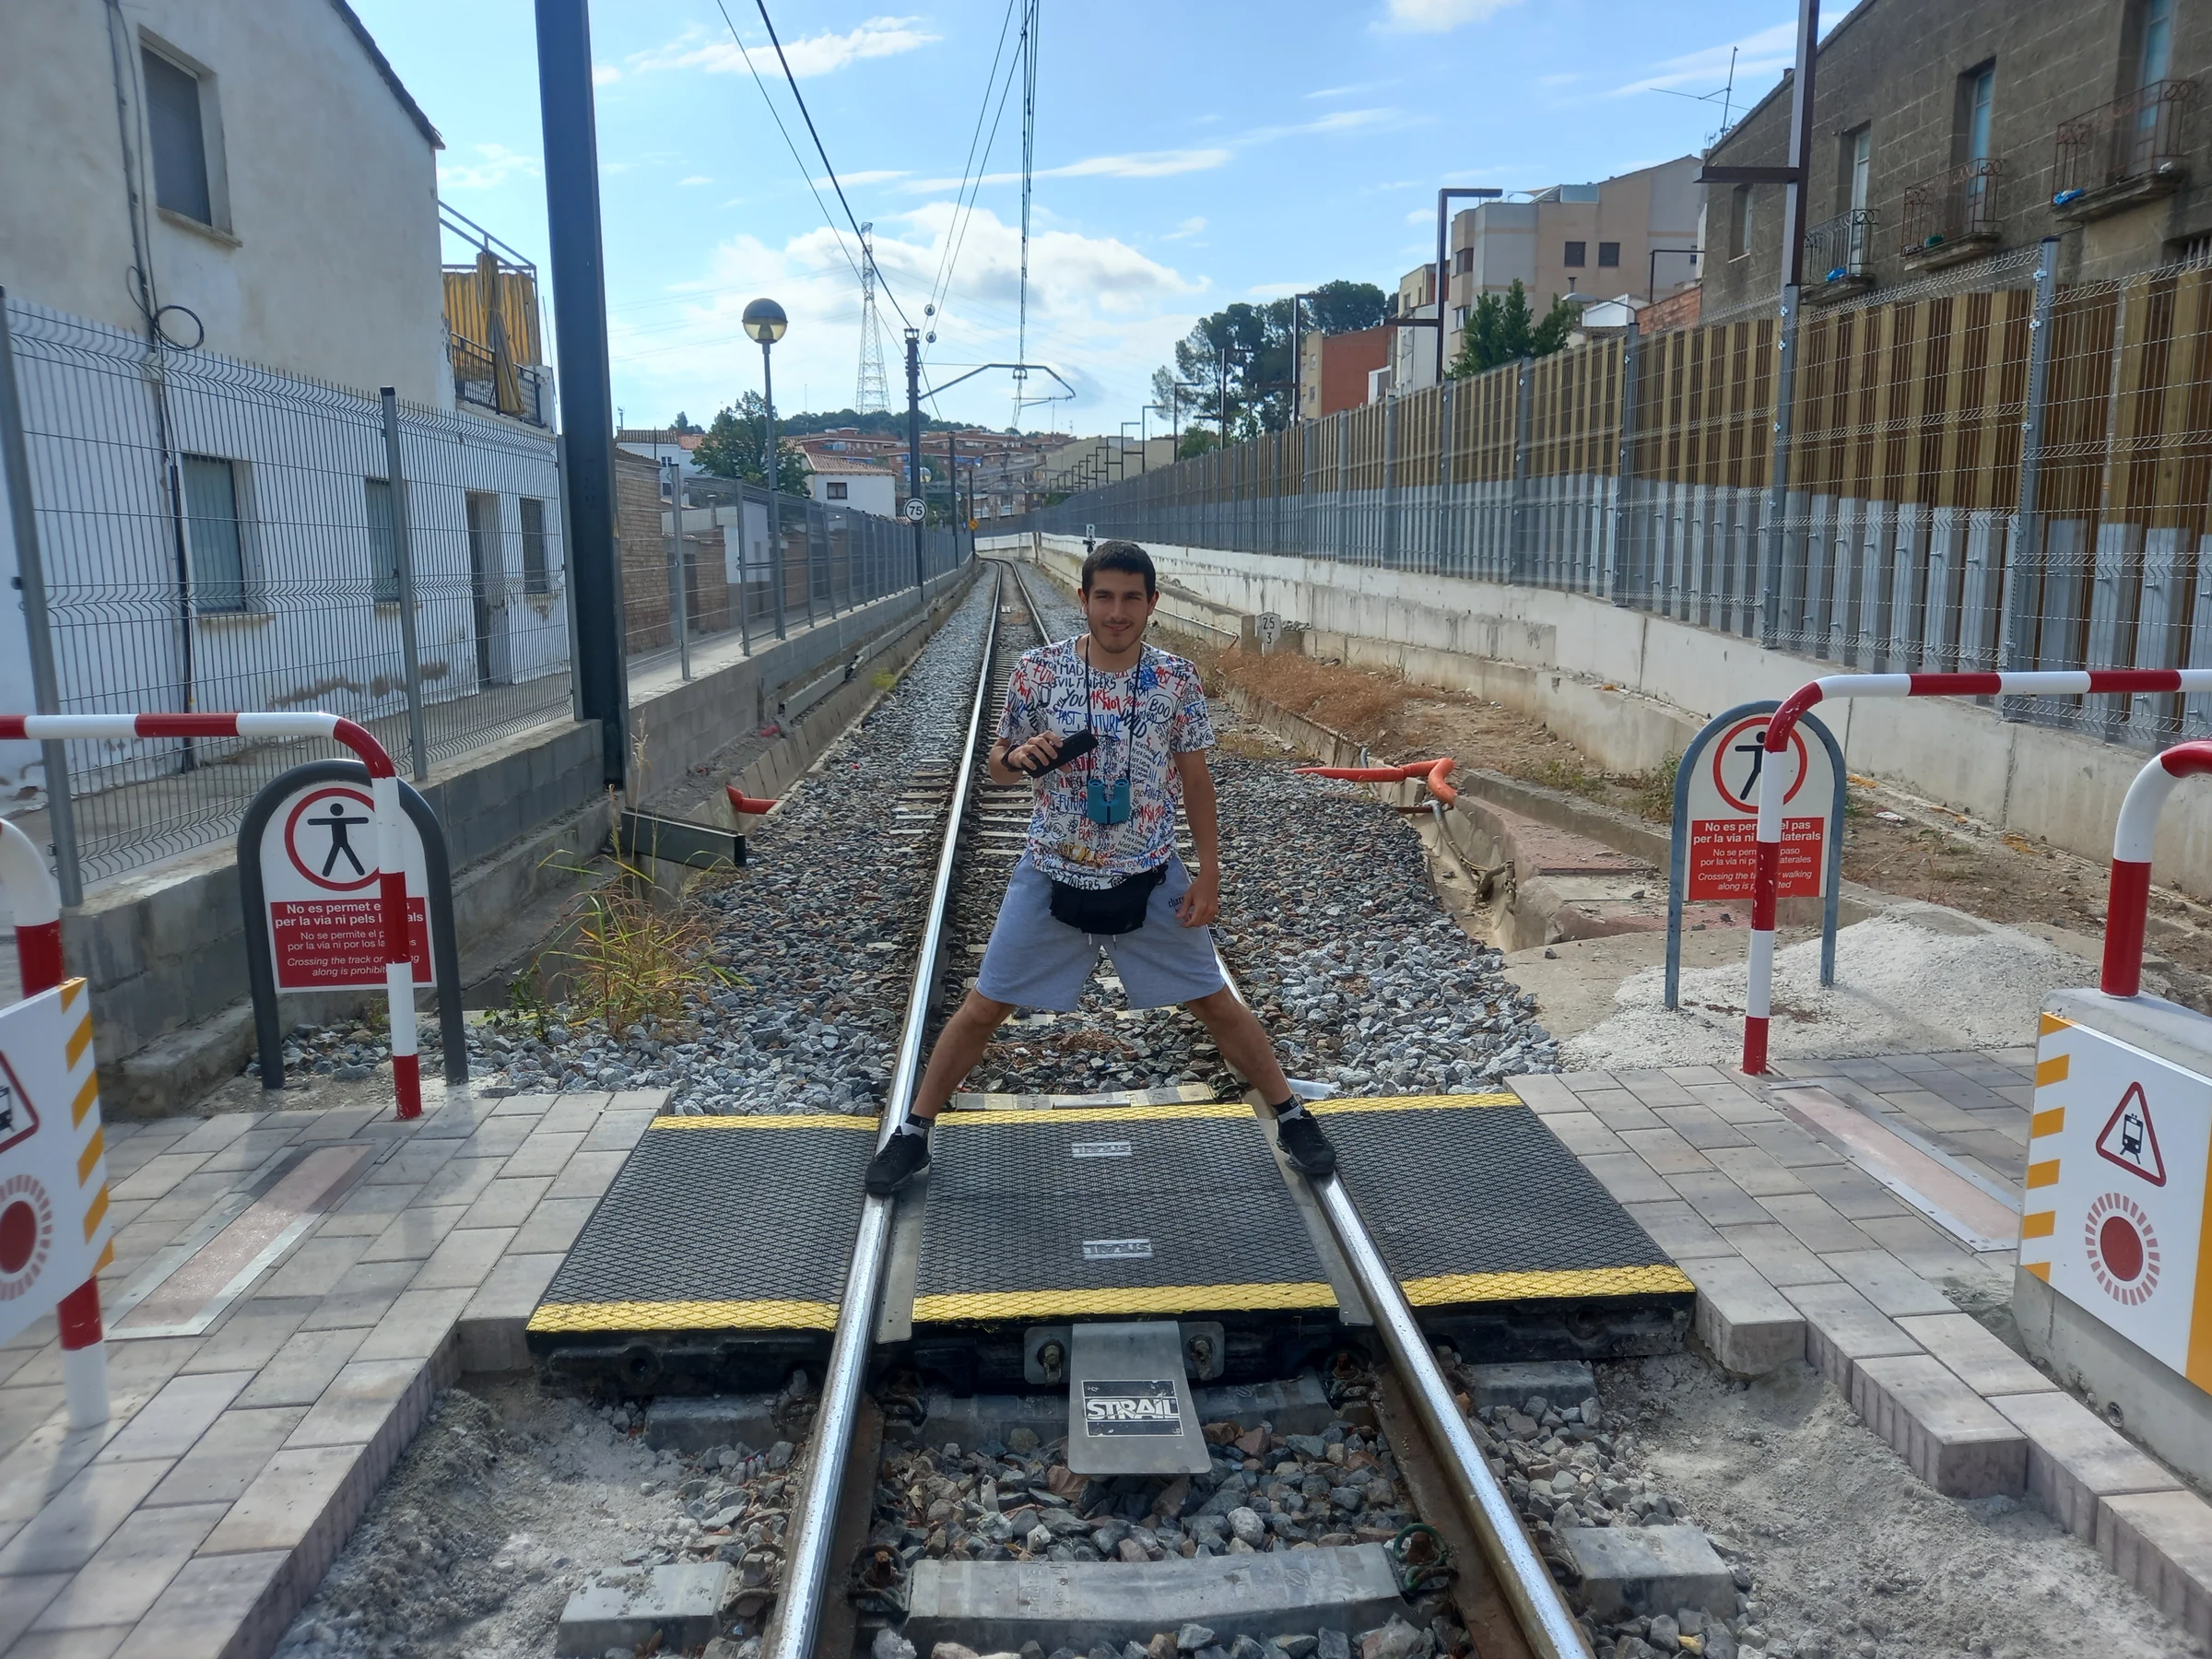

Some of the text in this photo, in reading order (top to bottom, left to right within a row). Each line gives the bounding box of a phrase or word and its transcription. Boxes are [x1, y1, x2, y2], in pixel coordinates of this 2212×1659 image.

[909, 506, 923, 516] 75
[1263, 618, 1275, 629] 25
[1266, 632, 1272, 644] 3
[1060, 663, 1084, 677] MAD
[1061, 688, 1088, 709] YOU
[1148, 698, 1171, 718] BOO
[1056, 710, 1082, 725] PAST
[1705, 822, 1720, 831] No
[1738, 823, 1758, 833] per
[1792, 822, 1811, 831] pas
[1693, 831, 1821, 845] per la via ni laterals
[1712, 849, 1725, 857] No
[1781, 848, 1799, 857] paso
[1700, 859, 1714, 867] por
[1698, 873, 1733, 881] Crossing
[1783, 871, 1812, 879] walking
[287, 904, 304, 914] No
[326, 902, 371, 914] permet
[276, 918, 296, 929] per
[300, 916, 311, 925] la
[312, 915, 332, 925] via
[335, 914, 347, 924] ni
[350, 913, 375, 926] pels
[300, 932, 314, 940] No
[331, 930, 366, 941] permite
[369, 930, 376, 938] el
[288, 943, 303, 952] por
[306, 941, 314, 949] la
[334, 940, 341, 948] ni
[344, 941, 359, 949] por
[288, 958, 328, 966] Crossing
[348, 956, 371, 964] track
[312, 968, 337, 977] along
[350, 966, 387, 976] prohibit
[1088, 1399, 1180, 1419] STRAIL
